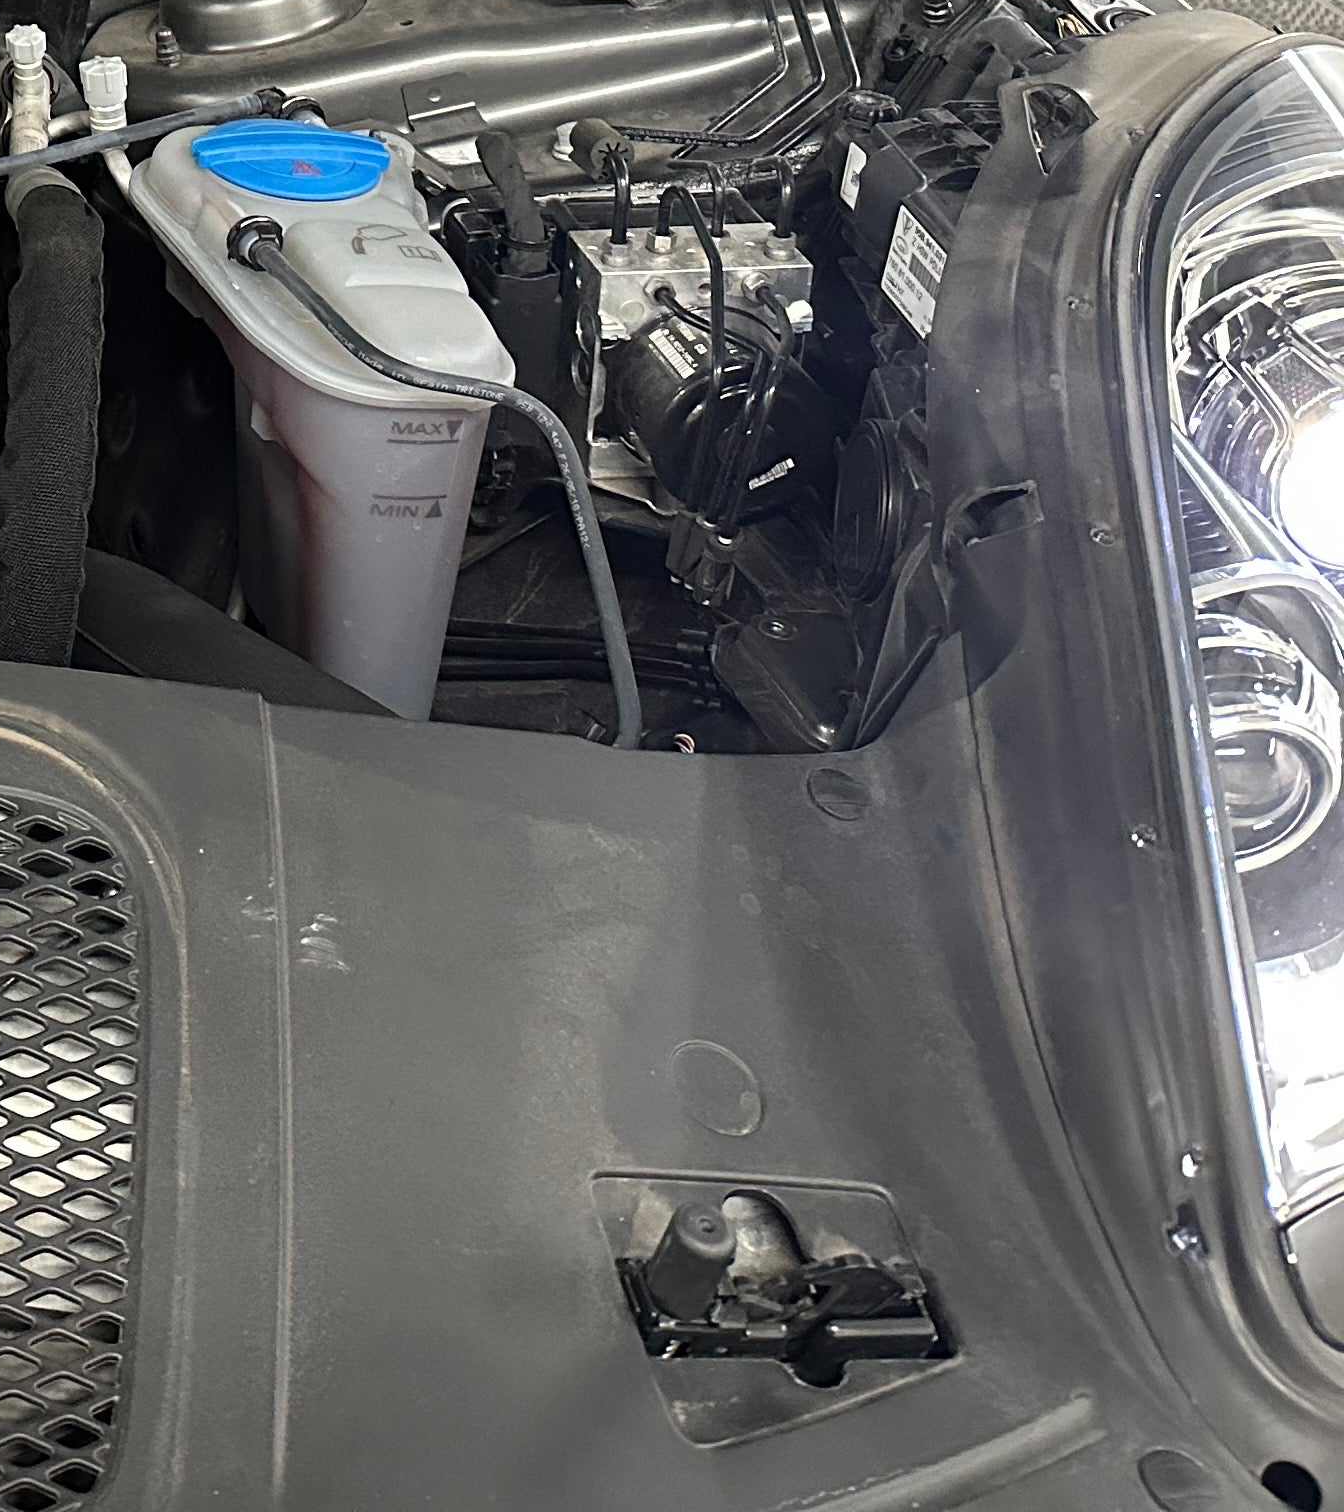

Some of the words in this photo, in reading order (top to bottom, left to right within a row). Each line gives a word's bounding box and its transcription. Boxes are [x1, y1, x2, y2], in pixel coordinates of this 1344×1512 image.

[455, 384, 507, 401] TRISTONE
[391, 421, 444, 435] MAX
[369, 504, 419, 518] MIN
